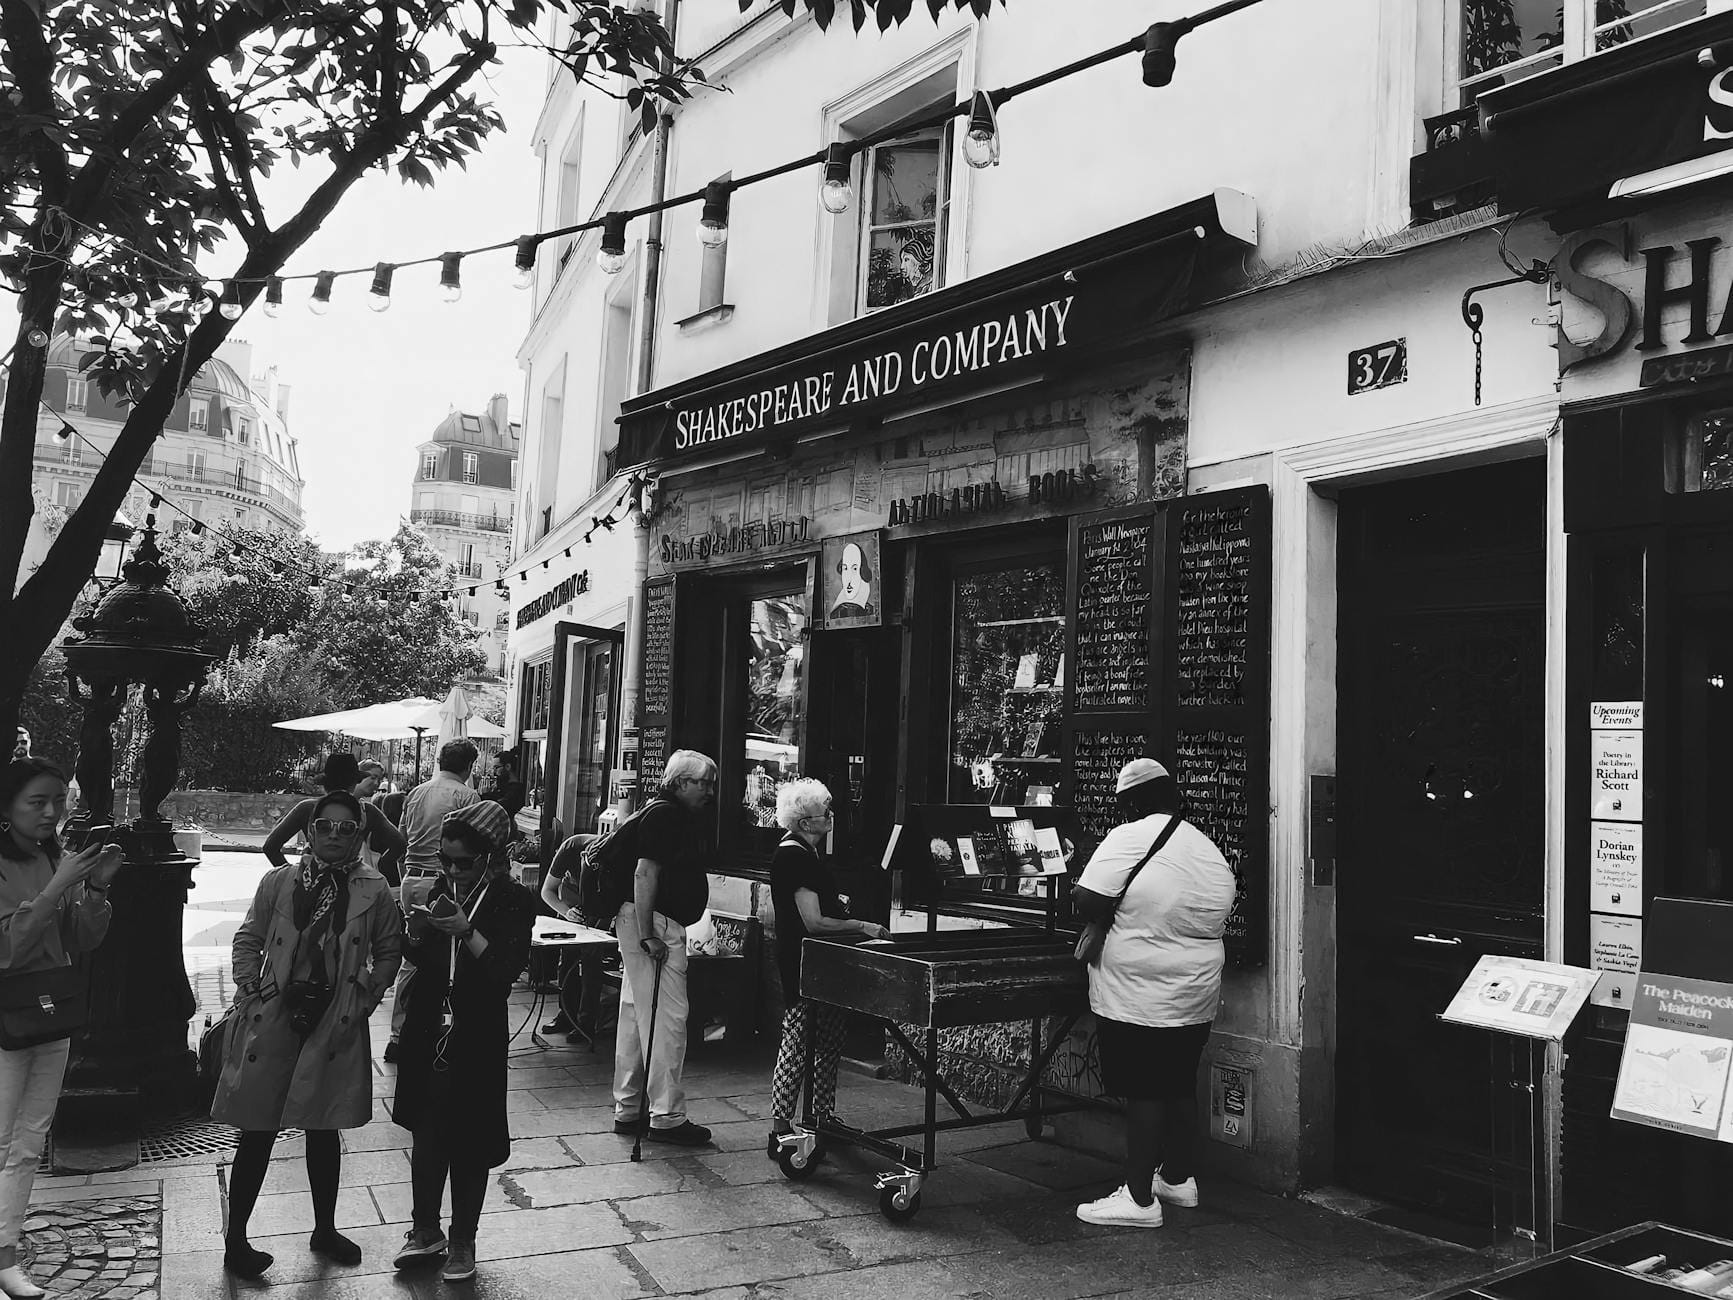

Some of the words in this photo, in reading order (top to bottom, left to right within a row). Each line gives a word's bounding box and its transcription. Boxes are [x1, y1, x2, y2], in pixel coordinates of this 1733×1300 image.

[675, 371, 835, 450] SHAKESPEARE
[838, 351, 902, 405] AND
[911, 296, 1075, 386] COMPANY
[1356, 346, 1397, 387] 37
[1593, 705, 1641, 718] Upcoming
[1602, 715, 1633, 725] Events
[1227, 735, 1245, 744] our
[1596, 768, 1639, 780] Richard
[1601, 779, 1630, 791] Scott
[1599, 839, 1635, 851] Dorian
[1596, 849, 1637, 865] Lynskey
[1642, 984, 1670, 999] The
[1672, 989, 1733, 1010] Peacock
[1658, 1000, 1713, 1020] Maiden
